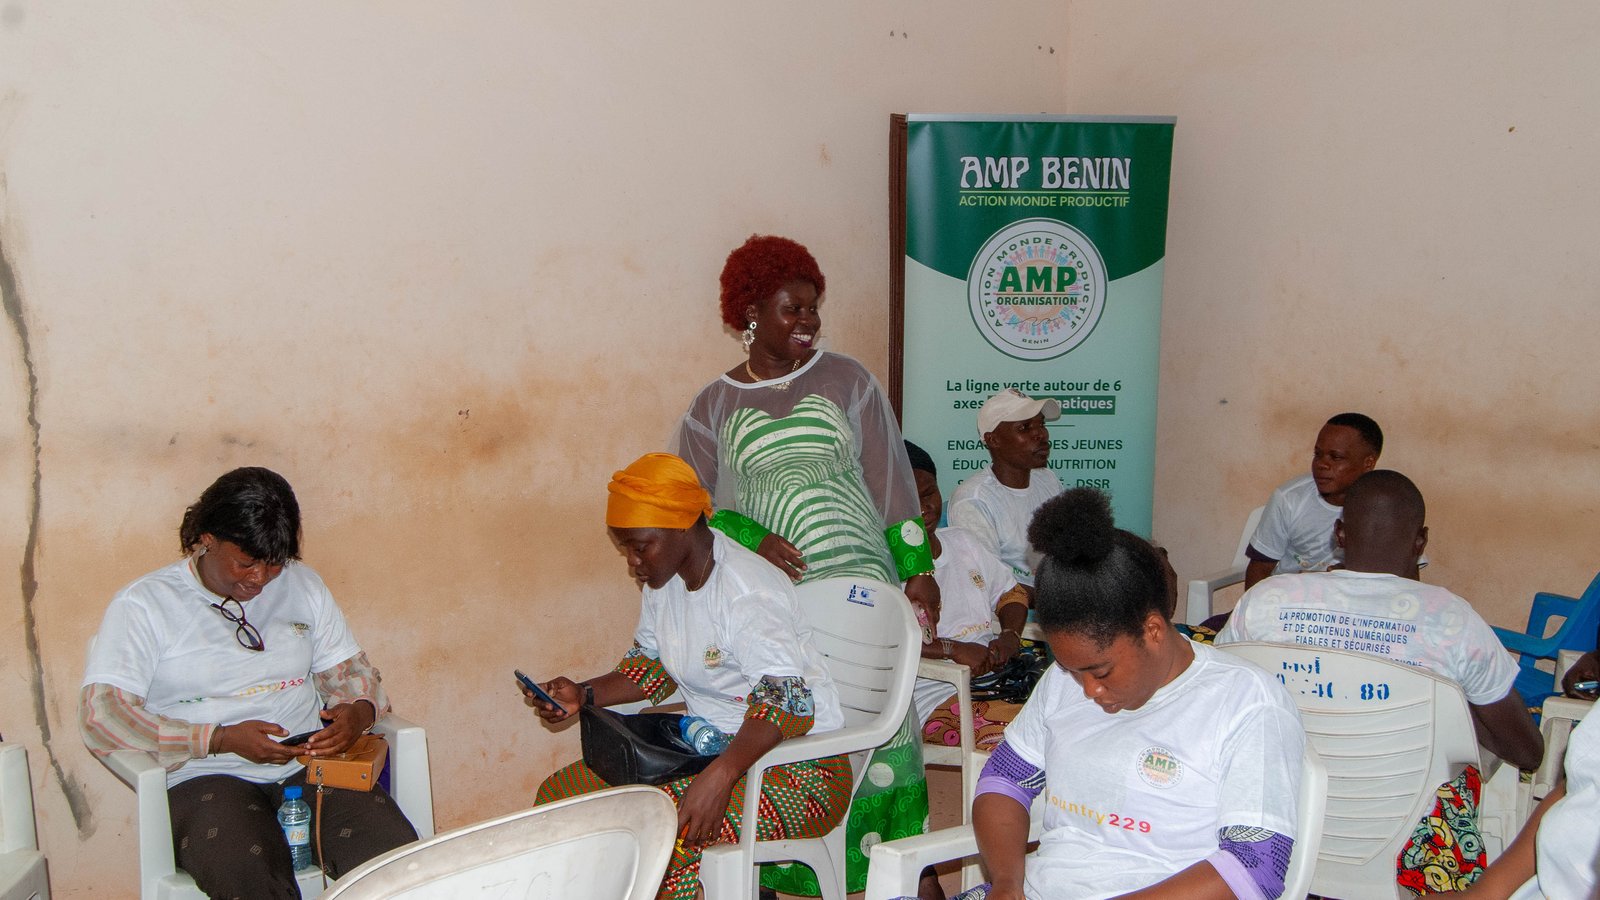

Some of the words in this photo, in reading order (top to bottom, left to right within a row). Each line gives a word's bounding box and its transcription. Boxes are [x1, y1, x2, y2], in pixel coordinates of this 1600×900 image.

[960, 156, 1030, 188] AMP
[1041, 156, 1132, 190] BENIN
[959, 195, 1007, 206] ACTION
[1010, 195, 1057, 207] MONDE
[1060, 196, 1131, 208] PRODUCTIF
[984, 267, 1004, 328] ACTION
[996, 237, 1054, 262] MONDE
[1059, 243, 1090, 330] PRODUCTIF
[997, 266, 1077, 292] AMP
[996, 296, 1078, 306] ORGANISATION
[946, 380, 962, 391] La
[966, 379, 1000, 394] ligne
[1003, 380, 1040, 391] verte
[1043, 381, 1090, 391] autour
[1093, 380, 1110, 391] de
[1113, 380, 1122, 391] 6
[953, 399, 984, 409] axes
[947, 439, 989, 451] ENGA
[1071, 439, 1123, 450] JEUNES
[1046, 458, 1117, 470] NUTRITION
[1076, 478, 1110, 489] DSSR
[1279, 612, 1288, 621] LA
[1290, 612, 1337, 624] PROMOTION
[1339, 616, 1350, 625] DE
[1352, 618, 1417, 633] L'INFORMATION
[1283, 623, 1293, 632] ET
[1295, 623, 1305, 633] DE
[1307, 624, 1351, 638] CONTENUS
[1353, 630, 1408, 645] NUMÉRIQUES
[1295, 635, 1329, 647] FIABLES
[1331, 639, 1341, 649] ET
[1344, 639, 1391, 655] SÉCURISÉS
[1144, 754, 1178, 771] AMP
